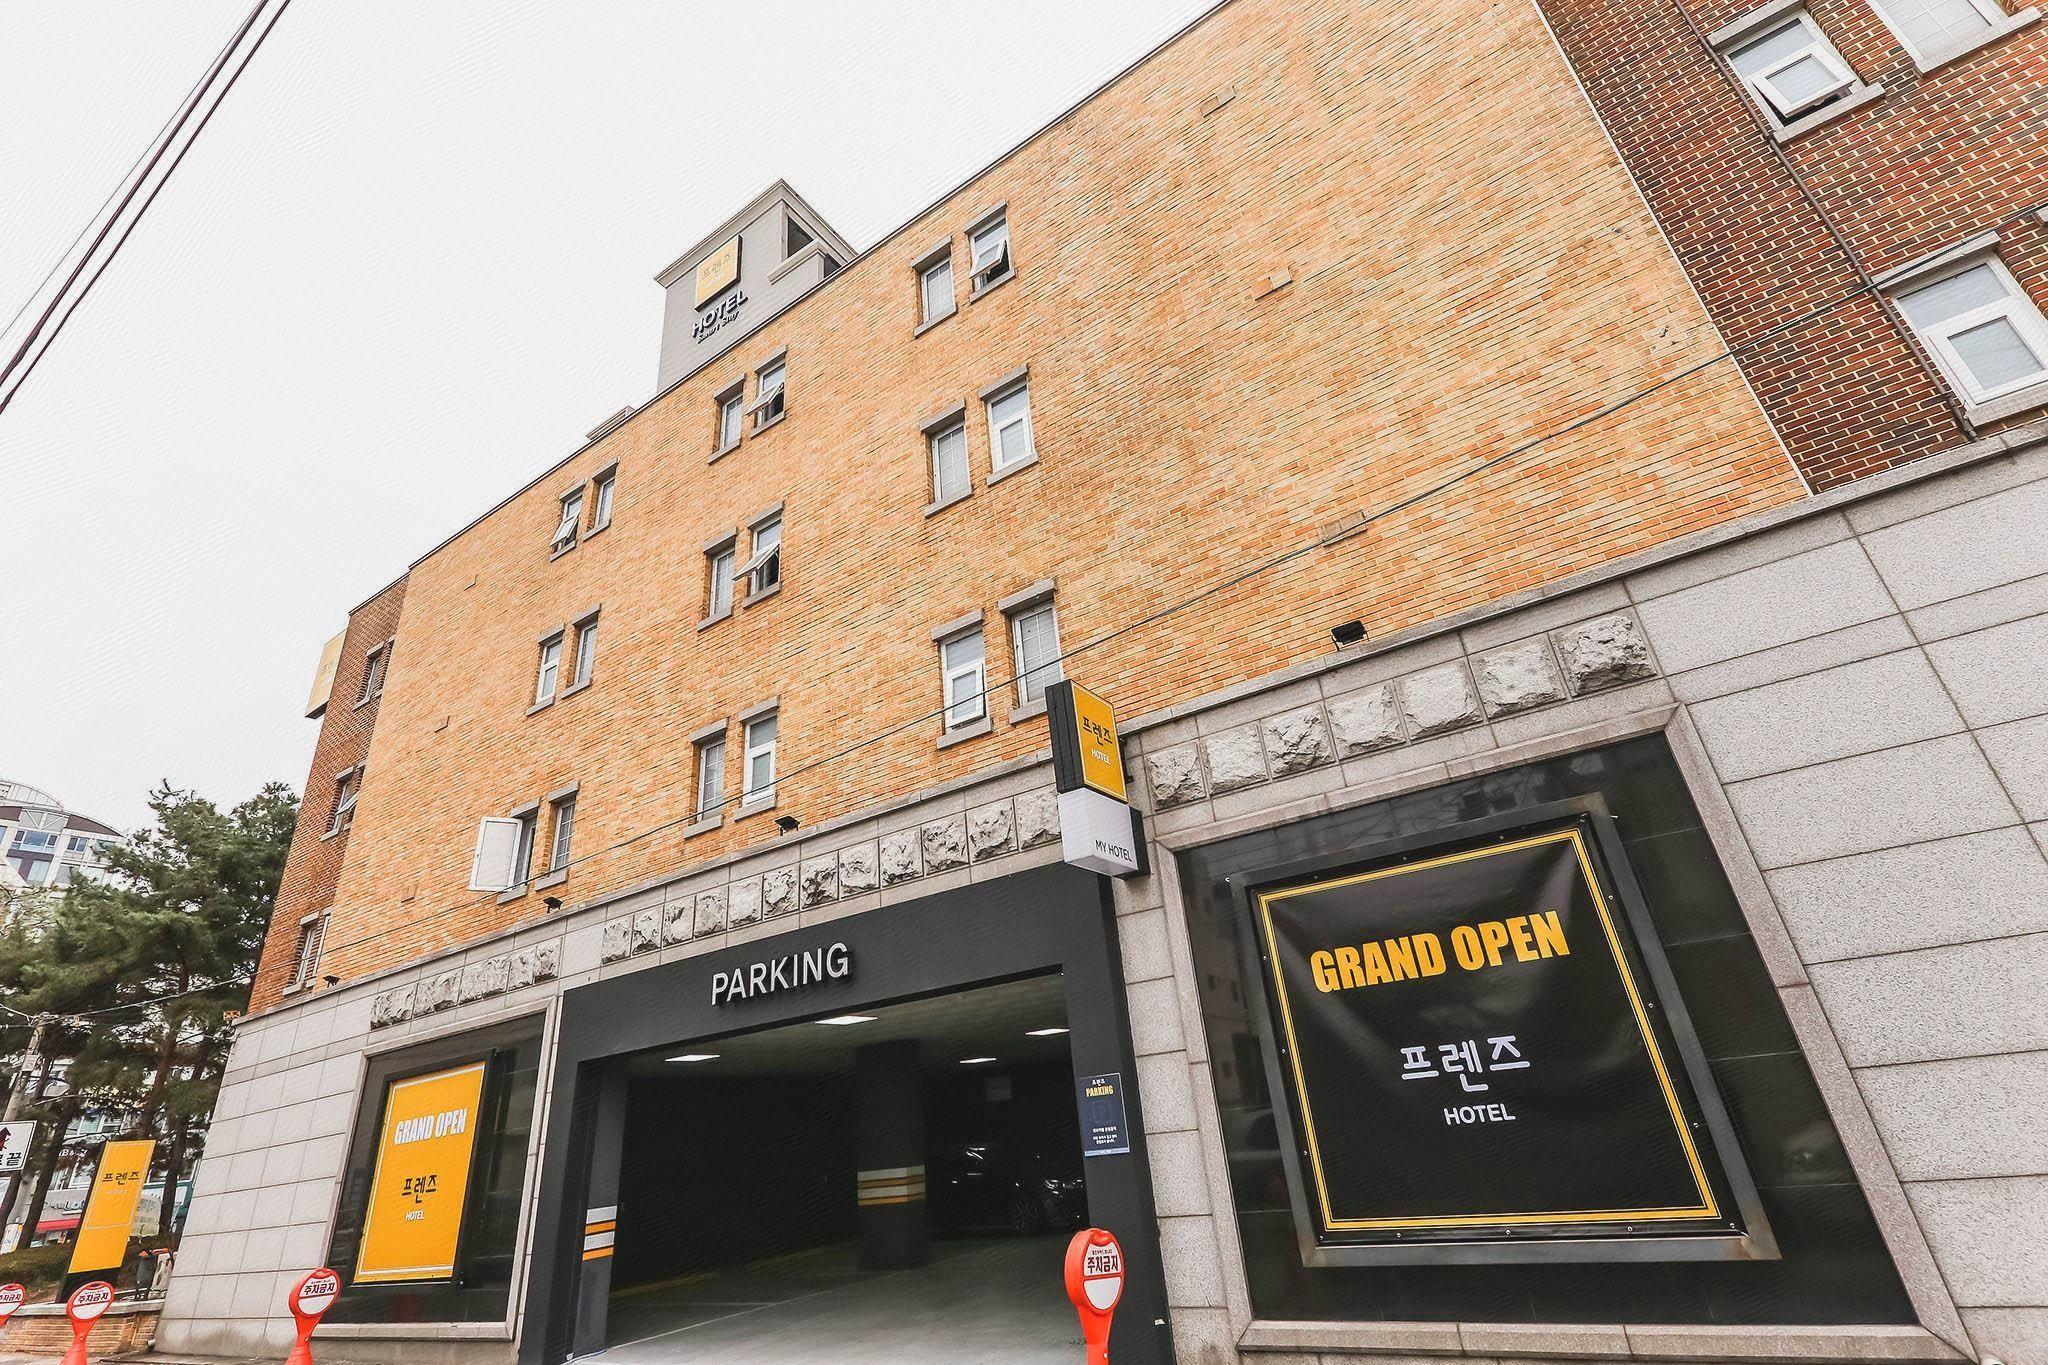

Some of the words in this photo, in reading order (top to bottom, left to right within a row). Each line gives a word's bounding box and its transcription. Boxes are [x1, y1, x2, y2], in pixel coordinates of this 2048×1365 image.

[692, 290, 749, 338] HOTEL
[1082, 716, 1113, 746] 프렌즈
[1091, 749, 1112, 765] HOTEL
[1095, 839, 1107, 853] MY
[1108, 843, 1133, 862] HOTEL
[1310, 931, 1447, 993] GRAND
[1451, 910, 1570, 971] OPEN
[711, 942, 849, 1006] PARKING
[1400, 1035, 1530, 1092] 프렌즈
[1085, 1085, 1114, 1097] PARKING
[394, 1115, 435, 1145] GRAND
[435, 1108, 467, 1138] OPEN
[1443, 1103, 1516, 1125] HOTEL
[102, 1171, 139, 1185] 프렌즈
[402, 1174, 437, 1203] 프렌즈
[405, 1210, 424, 1221] HOTEL
[1087, 1254, 1119, 1274] 주차금지
